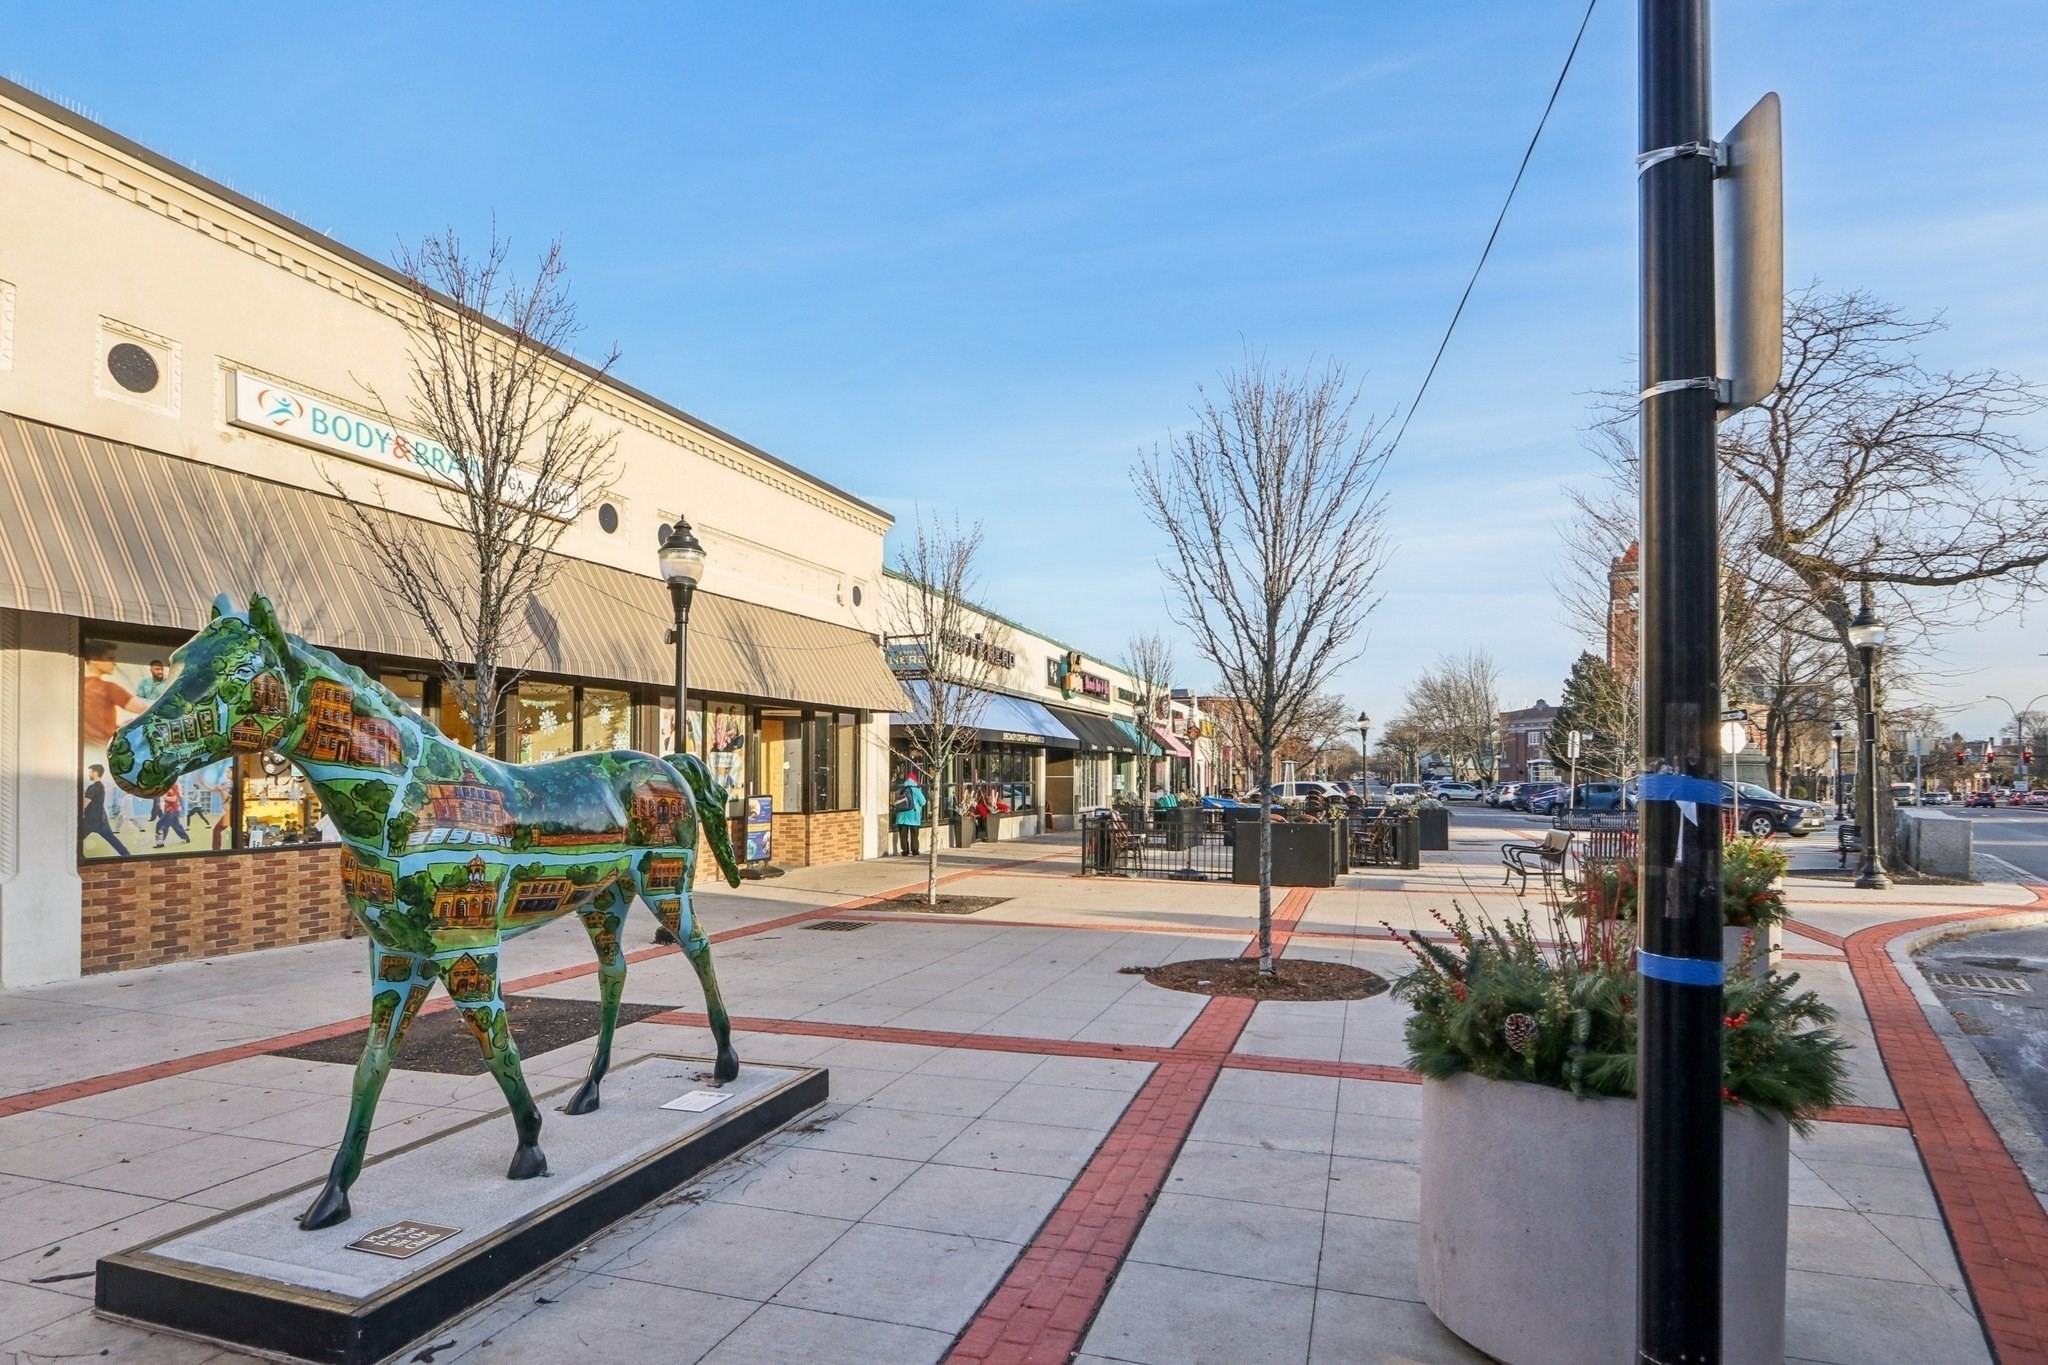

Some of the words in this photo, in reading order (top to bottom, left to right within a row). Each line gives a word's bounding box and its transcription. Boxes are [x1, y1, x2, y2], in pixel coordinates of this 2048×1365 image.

[987, 644, 1016, 668] NERO
[363, 1226, 404, 1243] Please
[374, 1237, 396, 1247] Do
[392, 1227, 420, 1238] Not
[405, 1233, 441, 1249] Climb
[408, 1231, 428, 1239] Or
